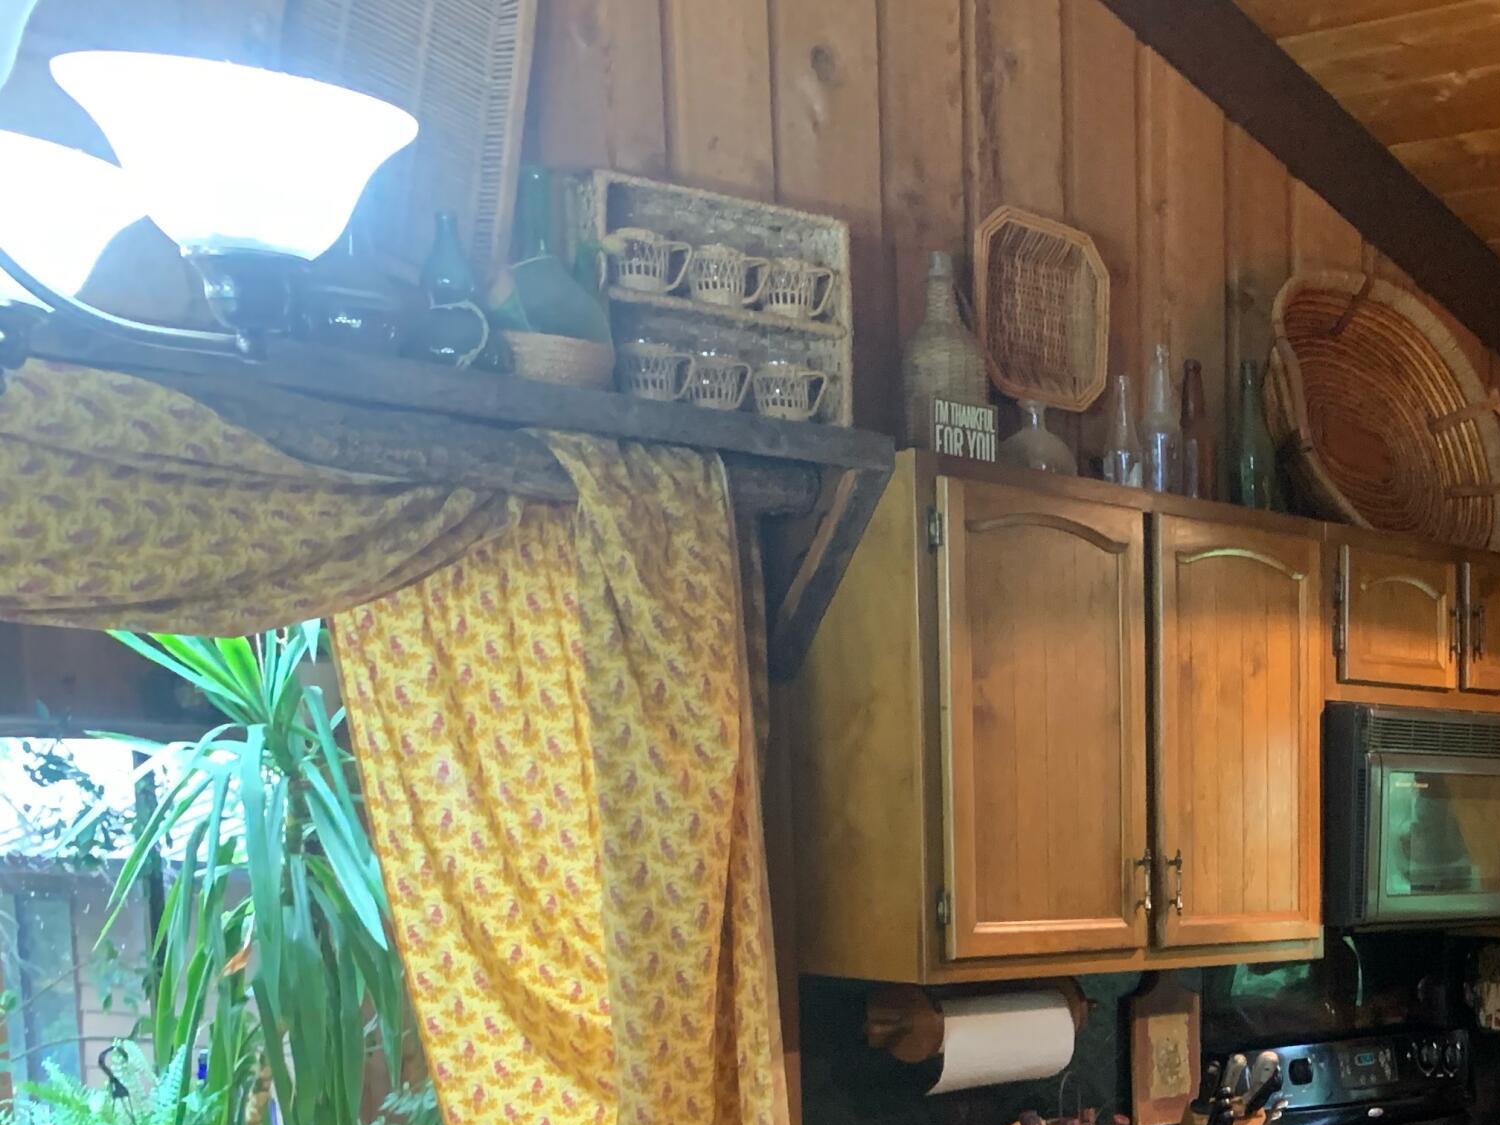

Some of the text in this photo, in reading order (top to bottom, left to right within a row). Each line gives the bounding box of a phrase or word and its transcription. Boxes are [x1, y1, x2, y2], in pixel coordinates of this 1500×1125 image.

[950, 402, 996, 433] THANKFUL
[935, 424, 996, 463] FOR YOU
